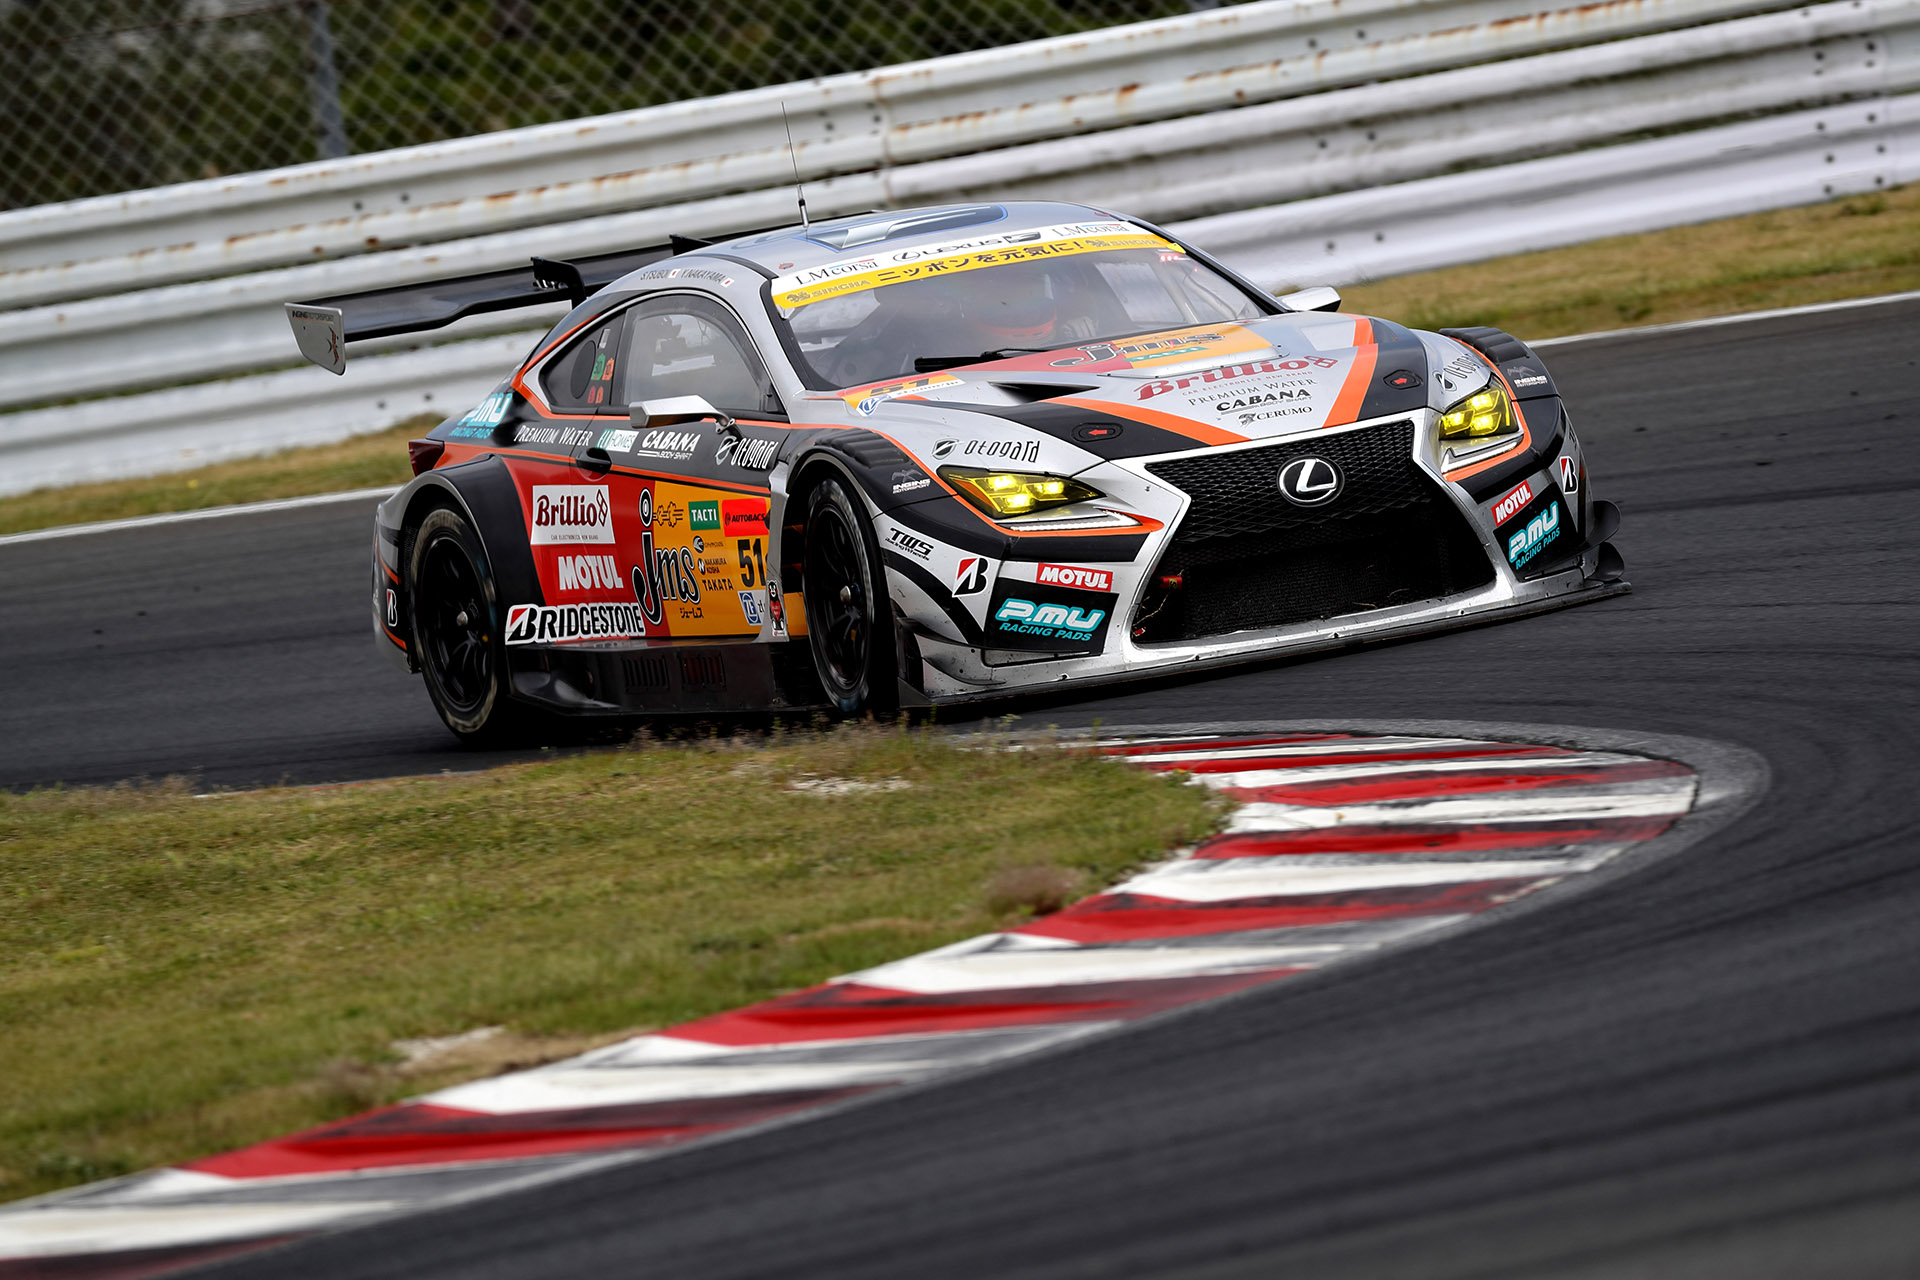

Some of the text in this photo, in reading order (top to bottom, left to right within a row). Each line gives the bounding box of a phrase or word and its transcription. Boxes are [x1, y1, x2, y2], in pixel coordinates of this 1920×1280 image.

[812, 279, 872, 298] SINGHA
[869, 378, 930, 396] 51
[1133, 360, 1309, 401] Brillio
[1188, 378, 1318, 406] PREMIUM WATER
[1216, 388, 1311, 411] CABANA
[1257, 406, 1313, 421] CERUMO
[513, 425, 560, 443] PREMIUM
[558, 426, 594, 446] WATER
[642, 430, 701, 452] CABANA
[963, 438, 1041, 463] otogard
[892, 478, 931, 491] INGING
[535, 494, 598, 527] Brillio
[691, 508, 717, 522] TACTI
[1494, 484, 1531, 523] MOTUL
[890, 527, 935, 556] TWS
[1509, 501, 1559, 563] P.MU
[1515, 527, 1560, 570] RACING PADS
[558, 555, 624, 590] MOTUL
[704, 557, 727, 565] NAKAMURA
[737, 538, 766, 588] 51
[702, 578, 734, 592] TAKATA
[1039, 566, 1108, 589] MOTUL
[506, 603, 645, 643] BRIDGESTONE
[996, 598, 1105, 632] P.MU
[999, 622, 1093, 642] RACING PADS
